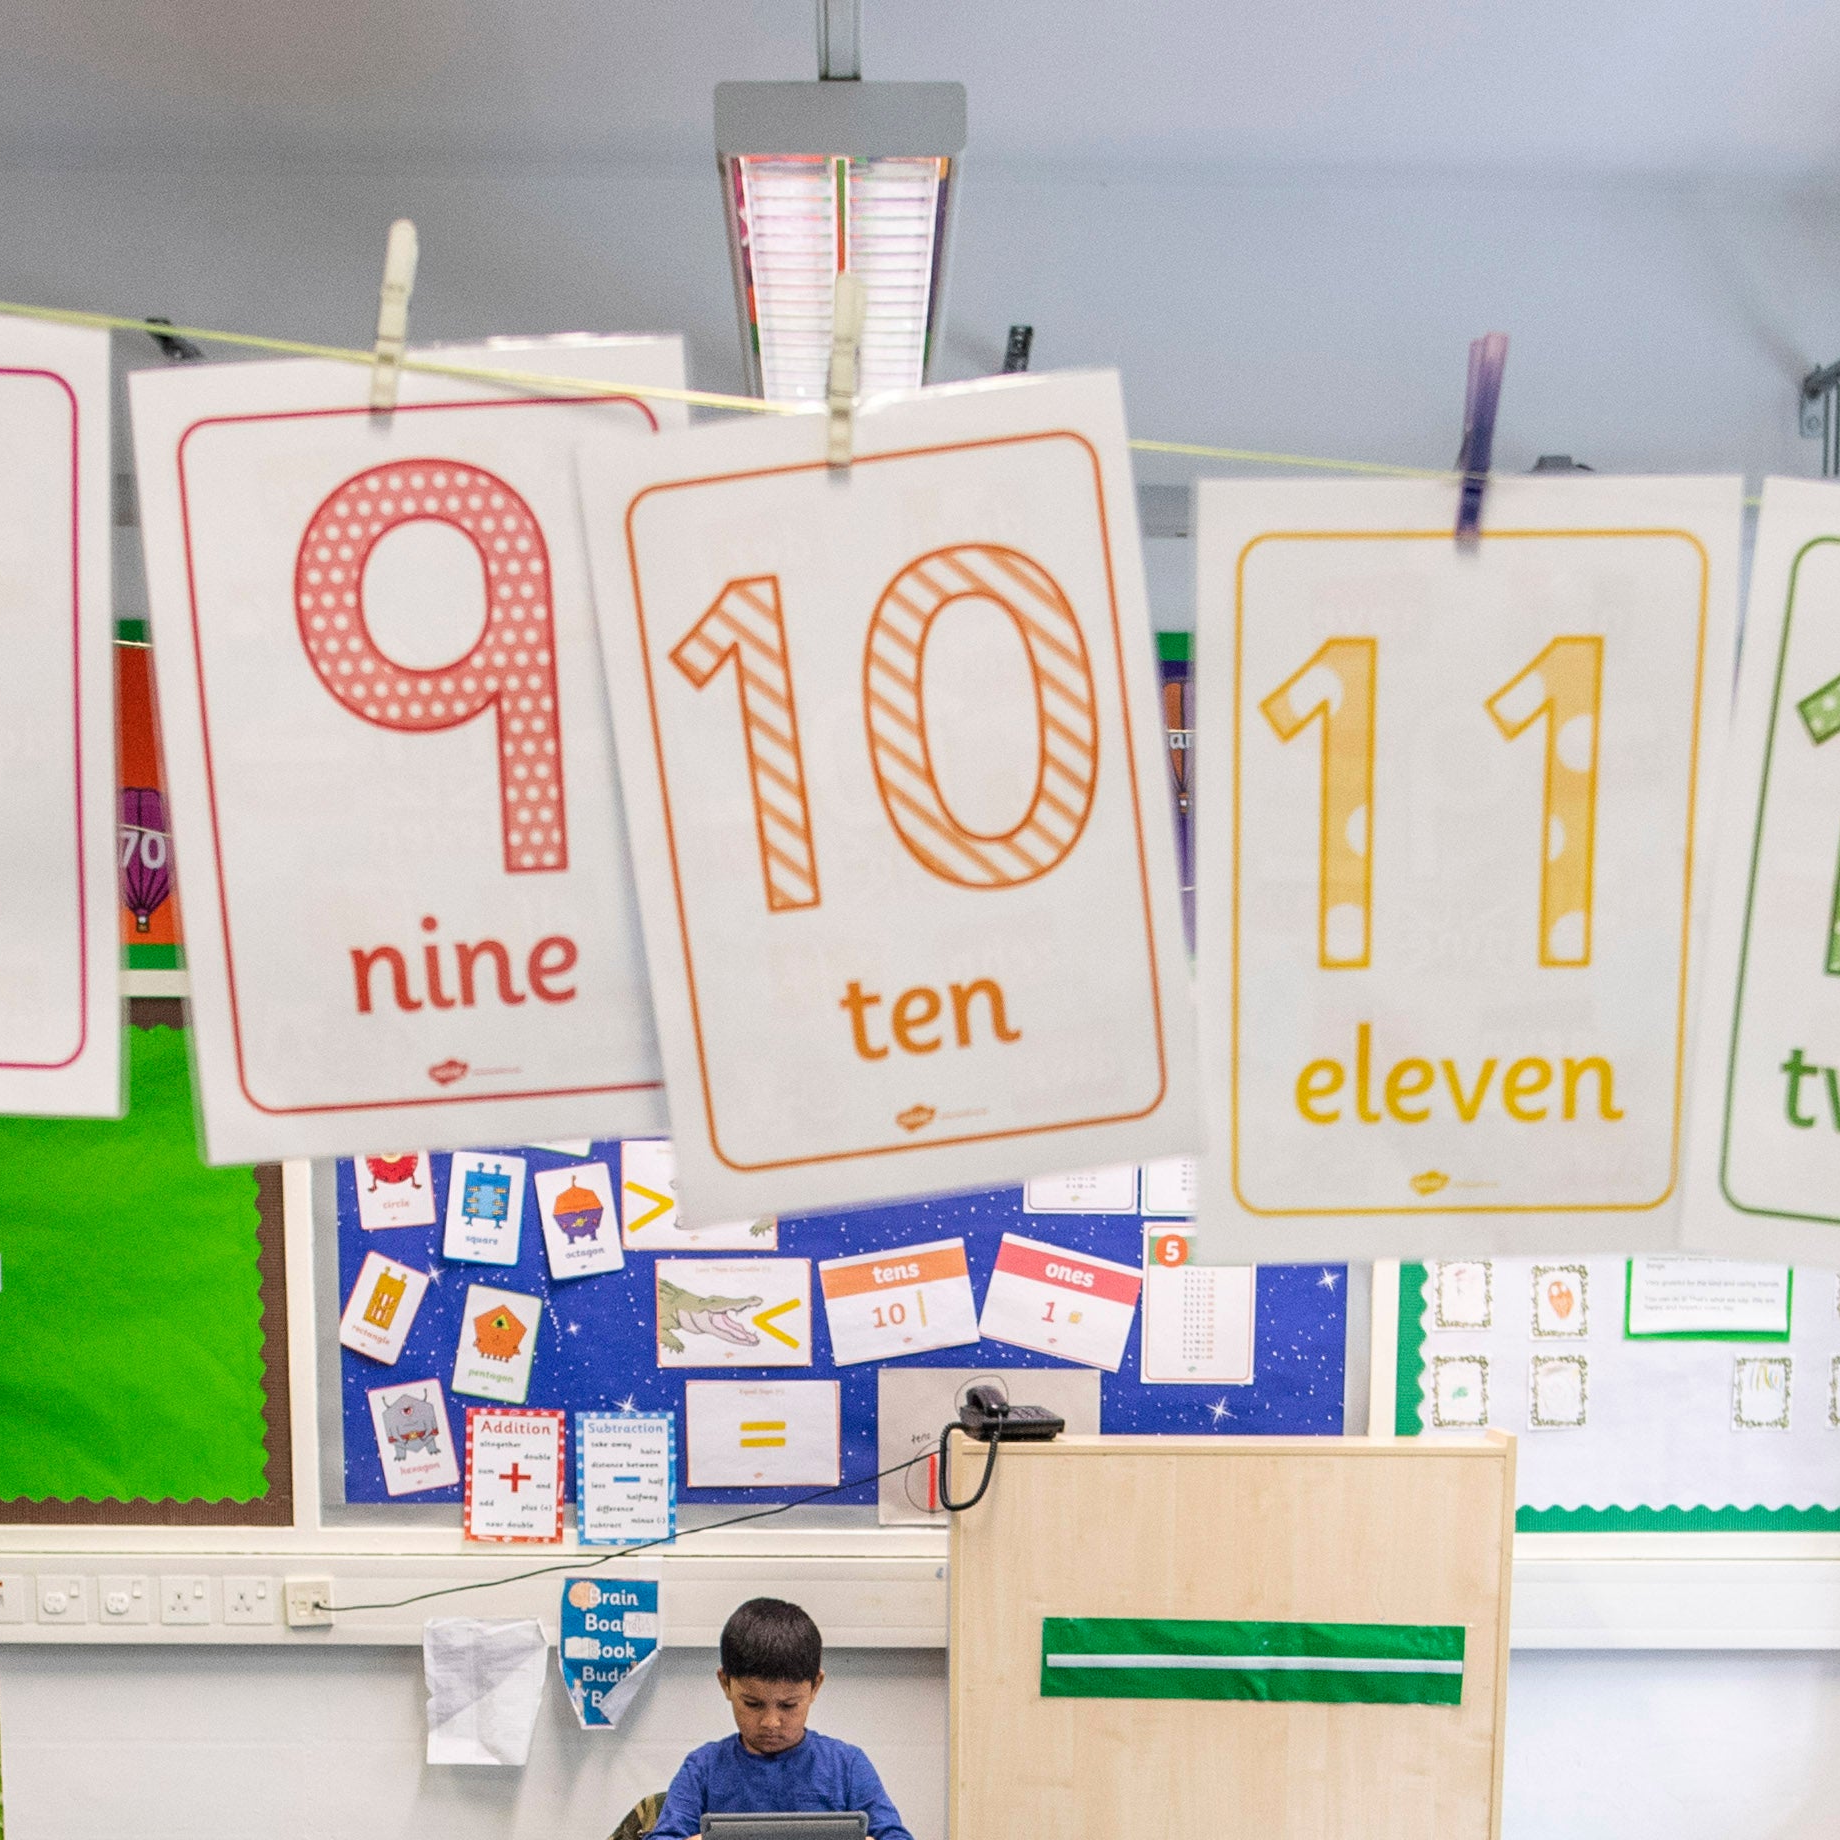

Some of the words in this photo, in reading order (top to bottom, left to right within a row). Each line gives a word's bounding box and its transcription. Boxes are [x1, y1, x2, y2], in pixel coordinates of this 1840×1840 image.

[296, 457, 568, 872] 9
[669, 542, 1101, 914] 10
[1260, 635, 1606, 970] 11
[348, 914, 580, 1016] nine
[840, 975, 1022, 1062] ten
[1294, 1021, 1624, 1125] eleven
[465, 1235, 498, 1246] square
[1165, 1240, 1180, 1262] 5
[565, 1247, 605, 1260] octagon
[872, 1262, 920, 1284] tens
[1045, 1262, 1094, 1288] ones
[872, 1303, 906, 1329] 10
[1041, 1302, 1056, 1323] 1
[353, 1324, 390, 1345] rectangle
[468, 1368, 514, 1383] pentagon
[481, 1420, 551, 1435] Addition
[588, 1423, 663, 1434] Subtraction
[480, 1441, 521, 1449] altogether
[400, 1462, 441, 1475] hexagon
[589, 1586, 638, 1605] Brain
